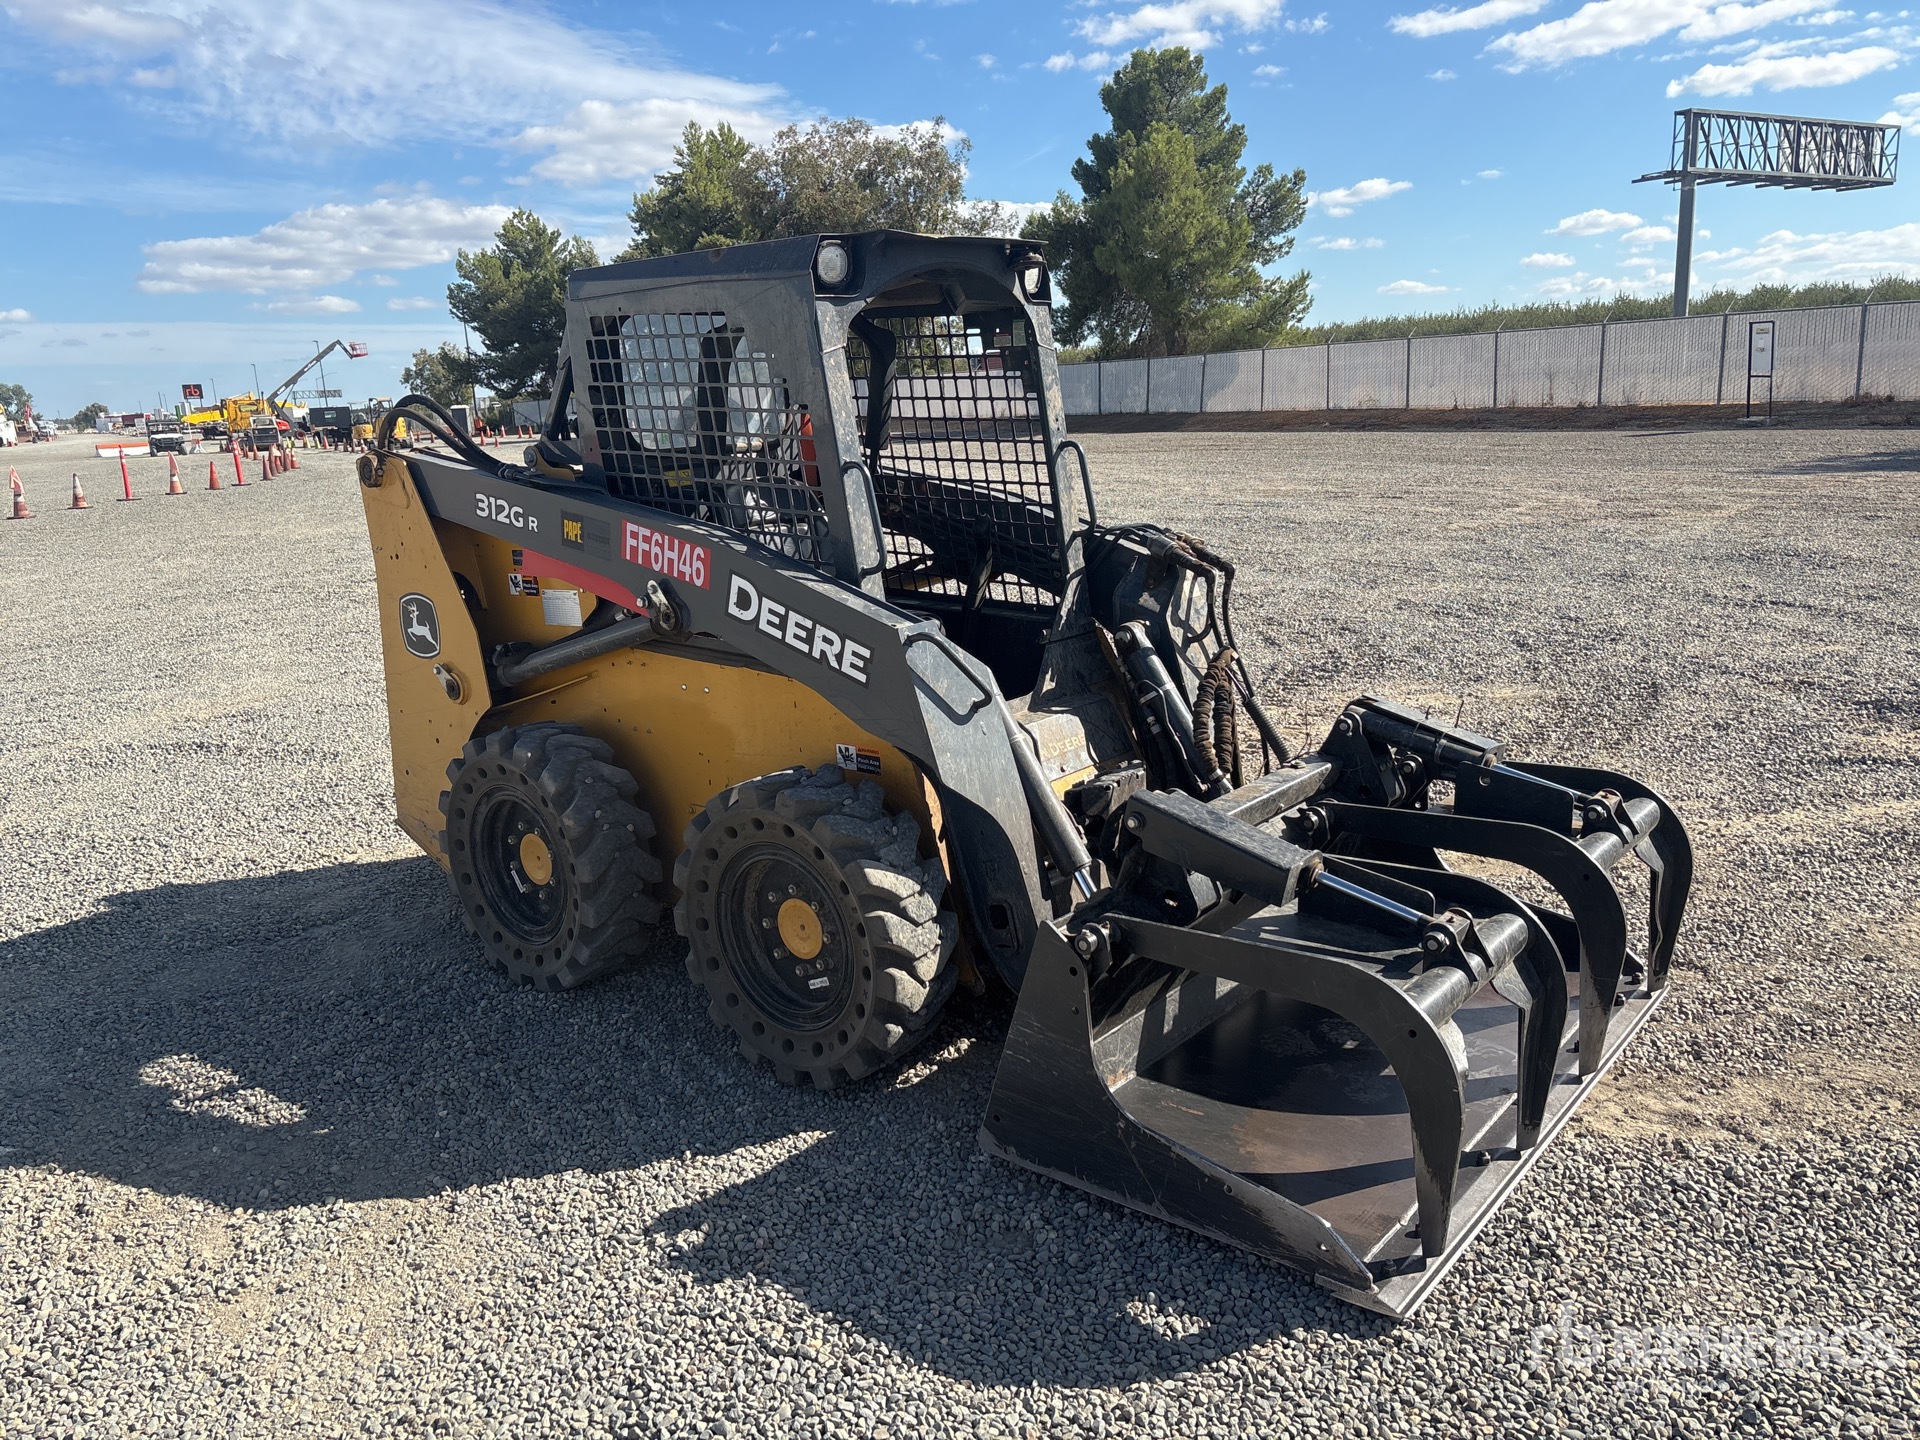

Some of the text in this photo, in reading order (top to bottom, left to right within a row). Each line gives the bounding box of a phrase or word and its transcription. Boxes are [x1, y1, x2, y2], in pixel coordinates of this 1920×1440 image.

[186, 385, 200, 396] rb
[475, 493, 538, 533] 312G R
[625, 522, 705, 588] FF6H46
[727, 574, 872, 684] DEERE
